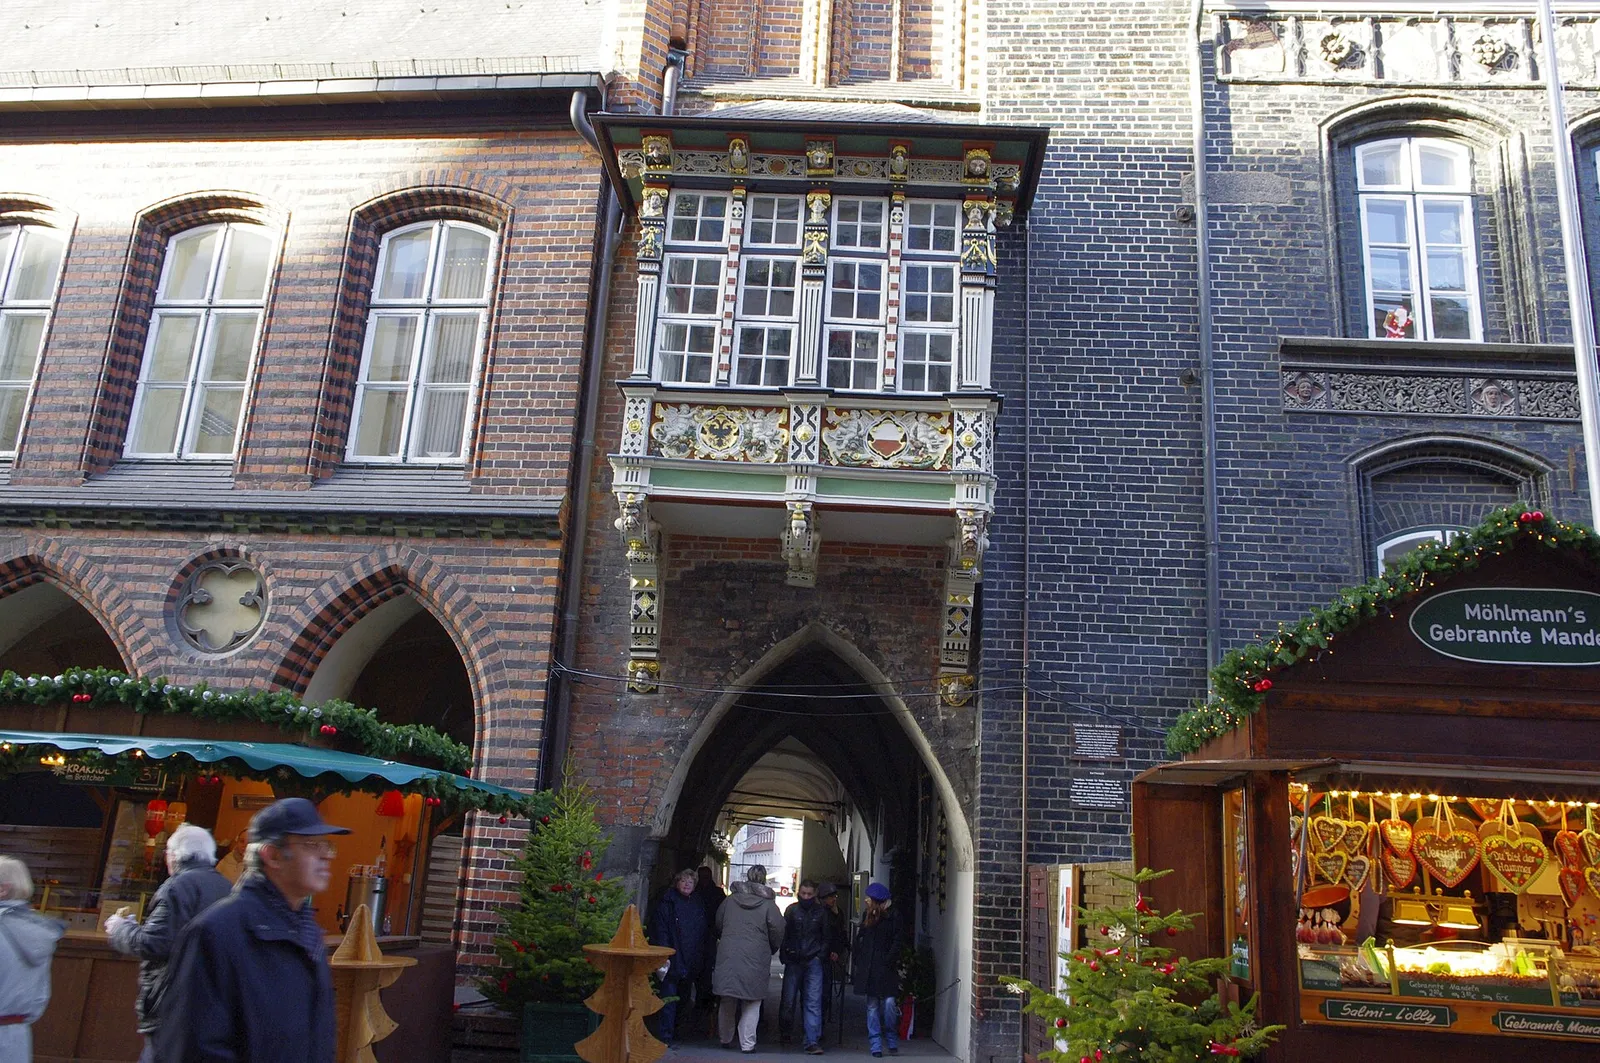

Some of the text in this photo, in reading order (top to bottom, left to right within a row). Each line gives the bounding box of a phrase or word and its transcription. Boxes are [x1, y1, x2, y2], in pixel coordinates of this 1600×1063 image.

[1464, 603, 1586, 623] Möhlmann's
[1429, 623, 1532, 644] Gebrannte
[1505, 849, 1521, 862] bist
[1522, 854, 1536, 863] der
[1497, 862, 1532, 874] Hammer
[1504, 1015, 1565, 1032] Gebrannte
